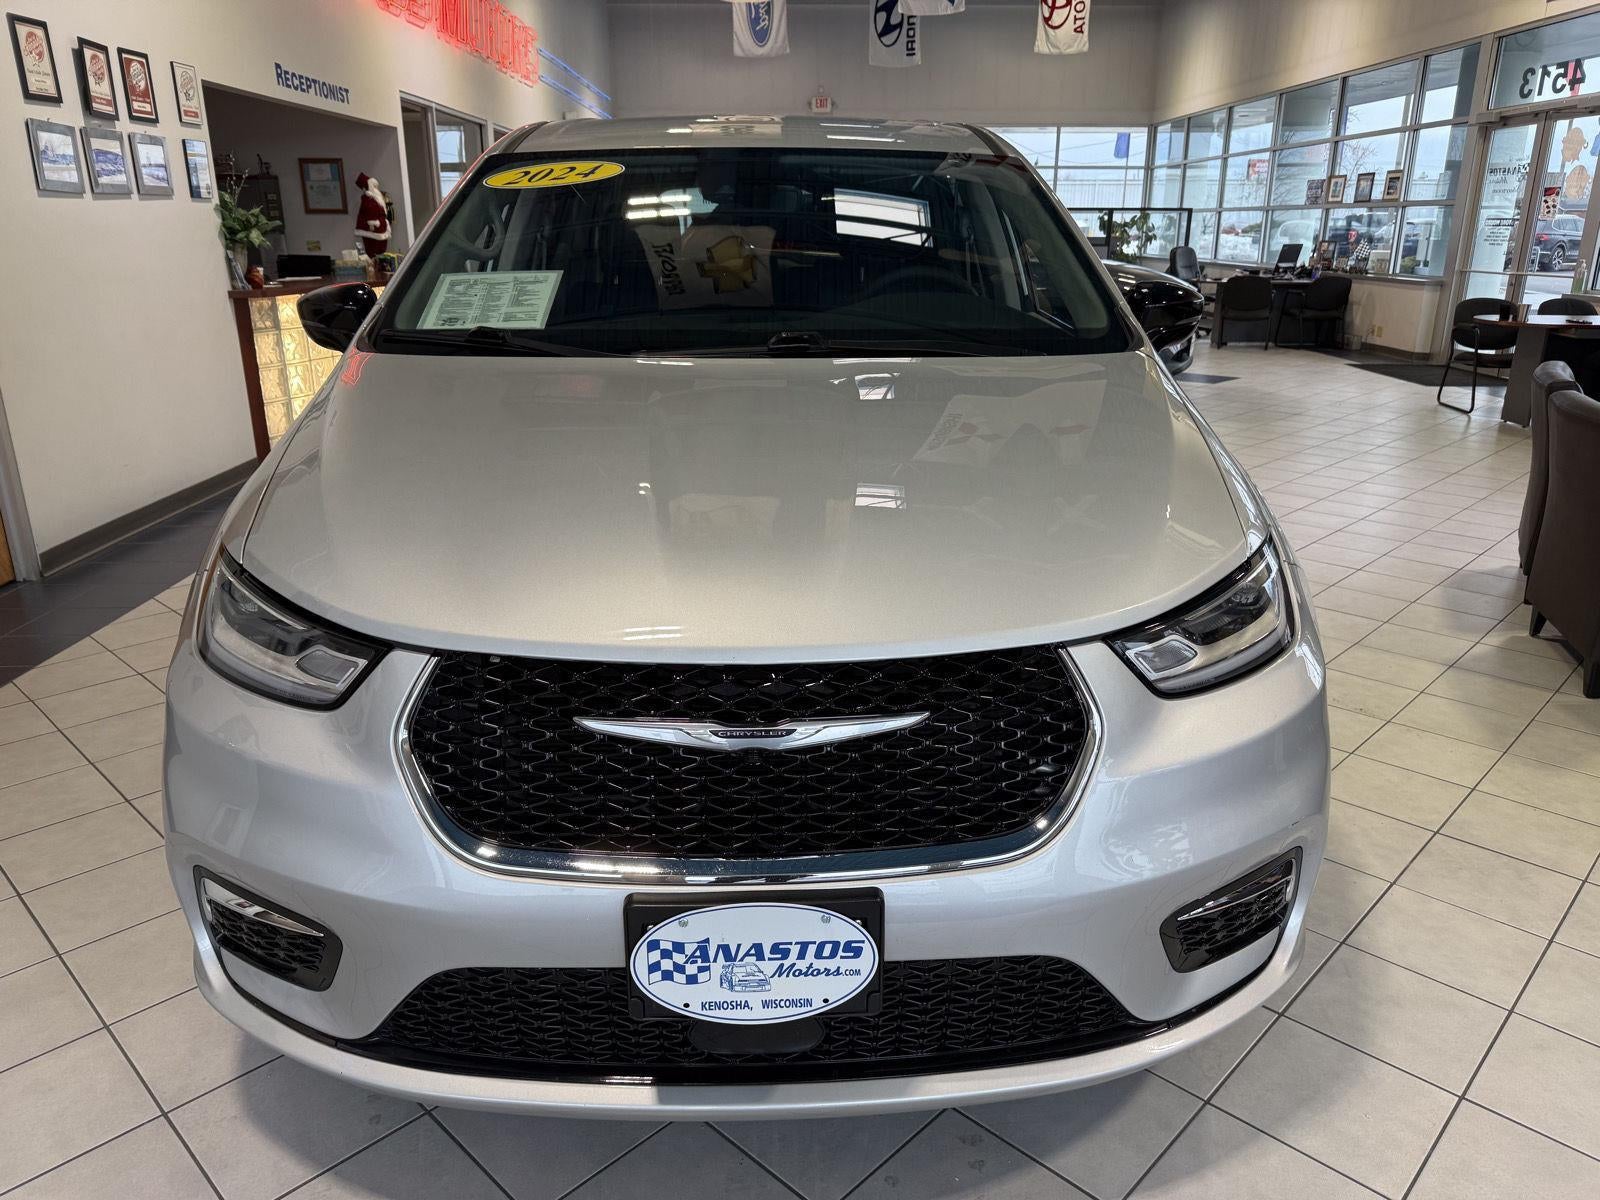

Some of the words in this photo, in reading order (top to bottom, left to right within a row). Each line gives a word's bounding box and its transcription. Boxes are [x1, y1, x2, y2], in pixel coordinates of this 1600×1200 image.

[274, 62, 350, 105] RECEPTIONIST
[815, 97, 829, 109] EXIT
[502, 163, 604, 185] 2024
[683, 940, 866, 964] ANASTOS
[701, 1000, 753, 1012] KENOSHA,
[761, 998, 813, 1009] WISCONSIN
